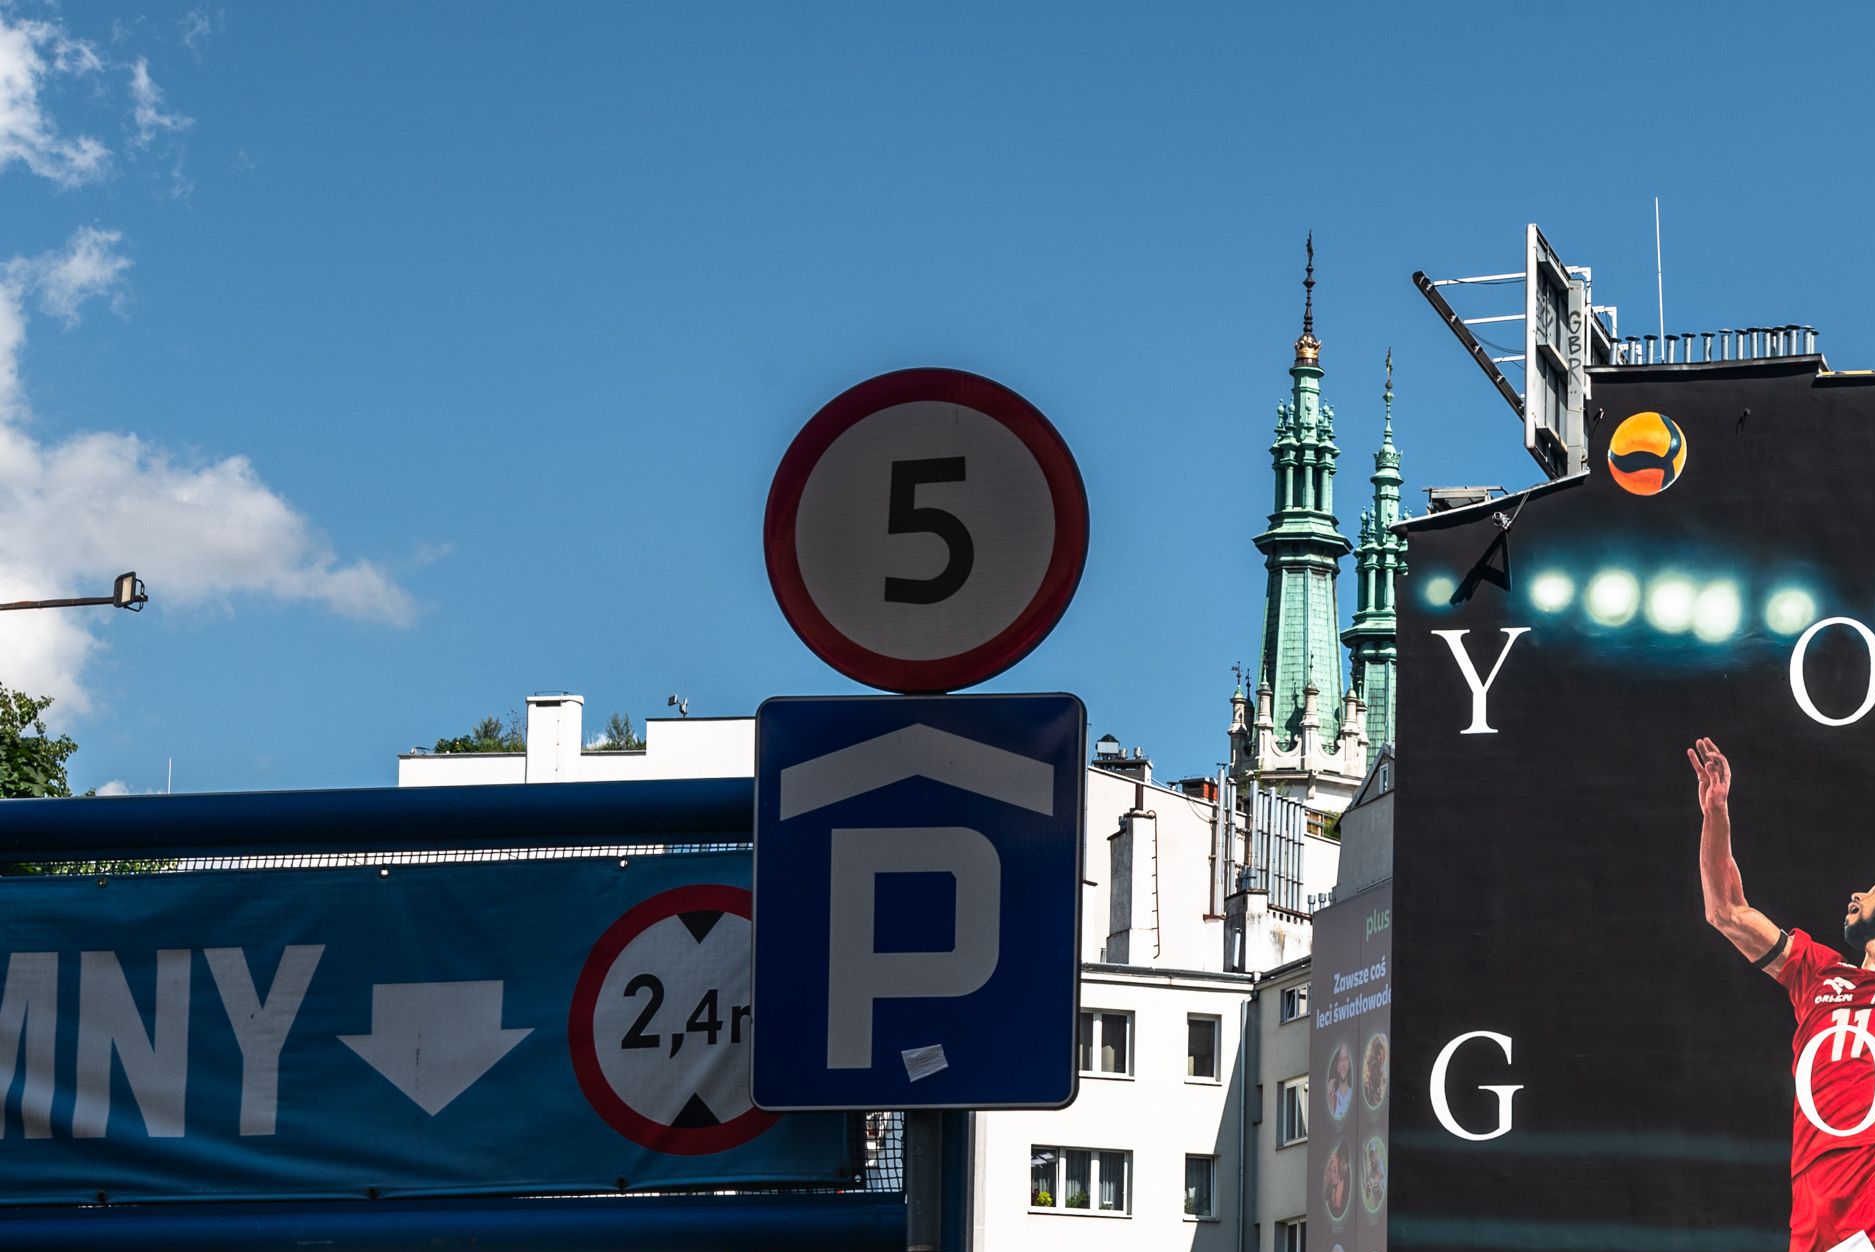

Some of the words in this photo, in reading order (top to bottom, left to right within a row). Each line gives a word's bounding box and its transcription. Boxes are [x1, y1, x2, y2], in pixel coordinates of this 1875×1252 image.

[884, 456, 974, 604] 5
[1366, 908, 1390, 942] plus
[827, 827, 1001, 1070] P
[1333, 969, 1369, 994] Zawsze
[1370, 956, 1387, 981] coś
[1316, 1003, 1332, 1030] leci
[1814, 993, 1853, 1004] ORLEN
